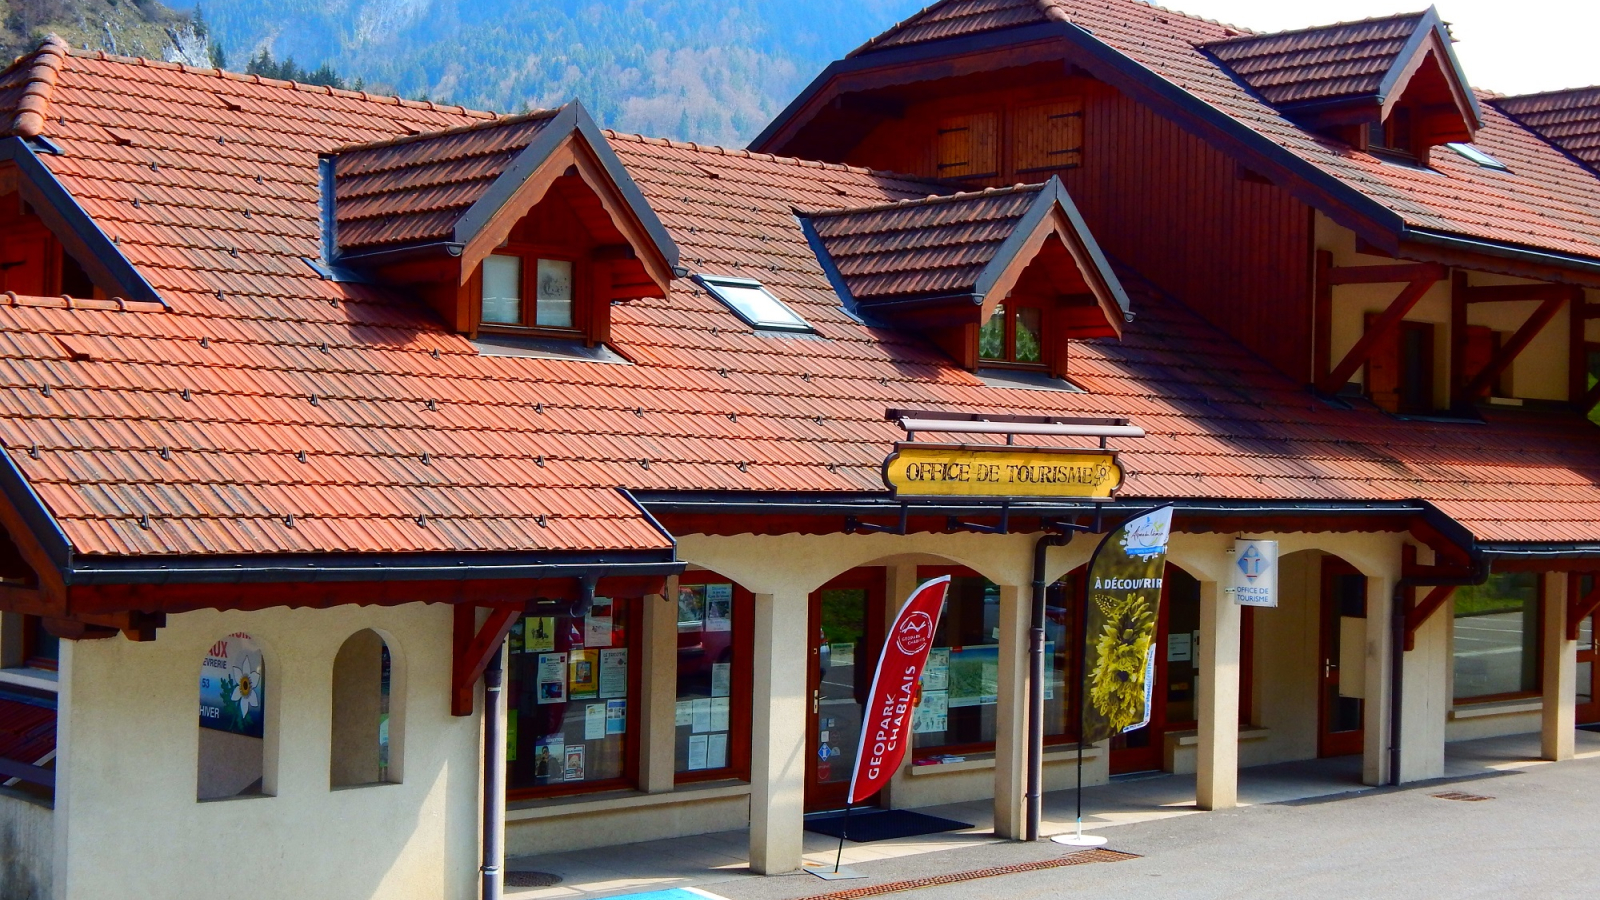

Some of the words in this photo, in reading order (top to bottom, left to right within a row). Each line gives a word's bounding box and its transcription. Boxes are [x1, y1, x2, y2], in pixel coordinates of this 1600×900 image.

[906, 461, 971, 482] OFFICE
[976, 463, 1000, 482] DE
[1006, 463, 1094, 484] TOURISME
[1094, 576, 1102, 589] À
[1104, 576, 1163, 589] DÉCOUVRIR
[1236, 586, 1258, 594] OFFICE
[1259, 587, 1269, 595] DE
[1236, 594, 1269, 603] TOURISME
[199, 705, 220, 719] HIVER
[887, 665, 916, 751] CHABLAIS
[868, 693, 896, 780] GEOPARK
